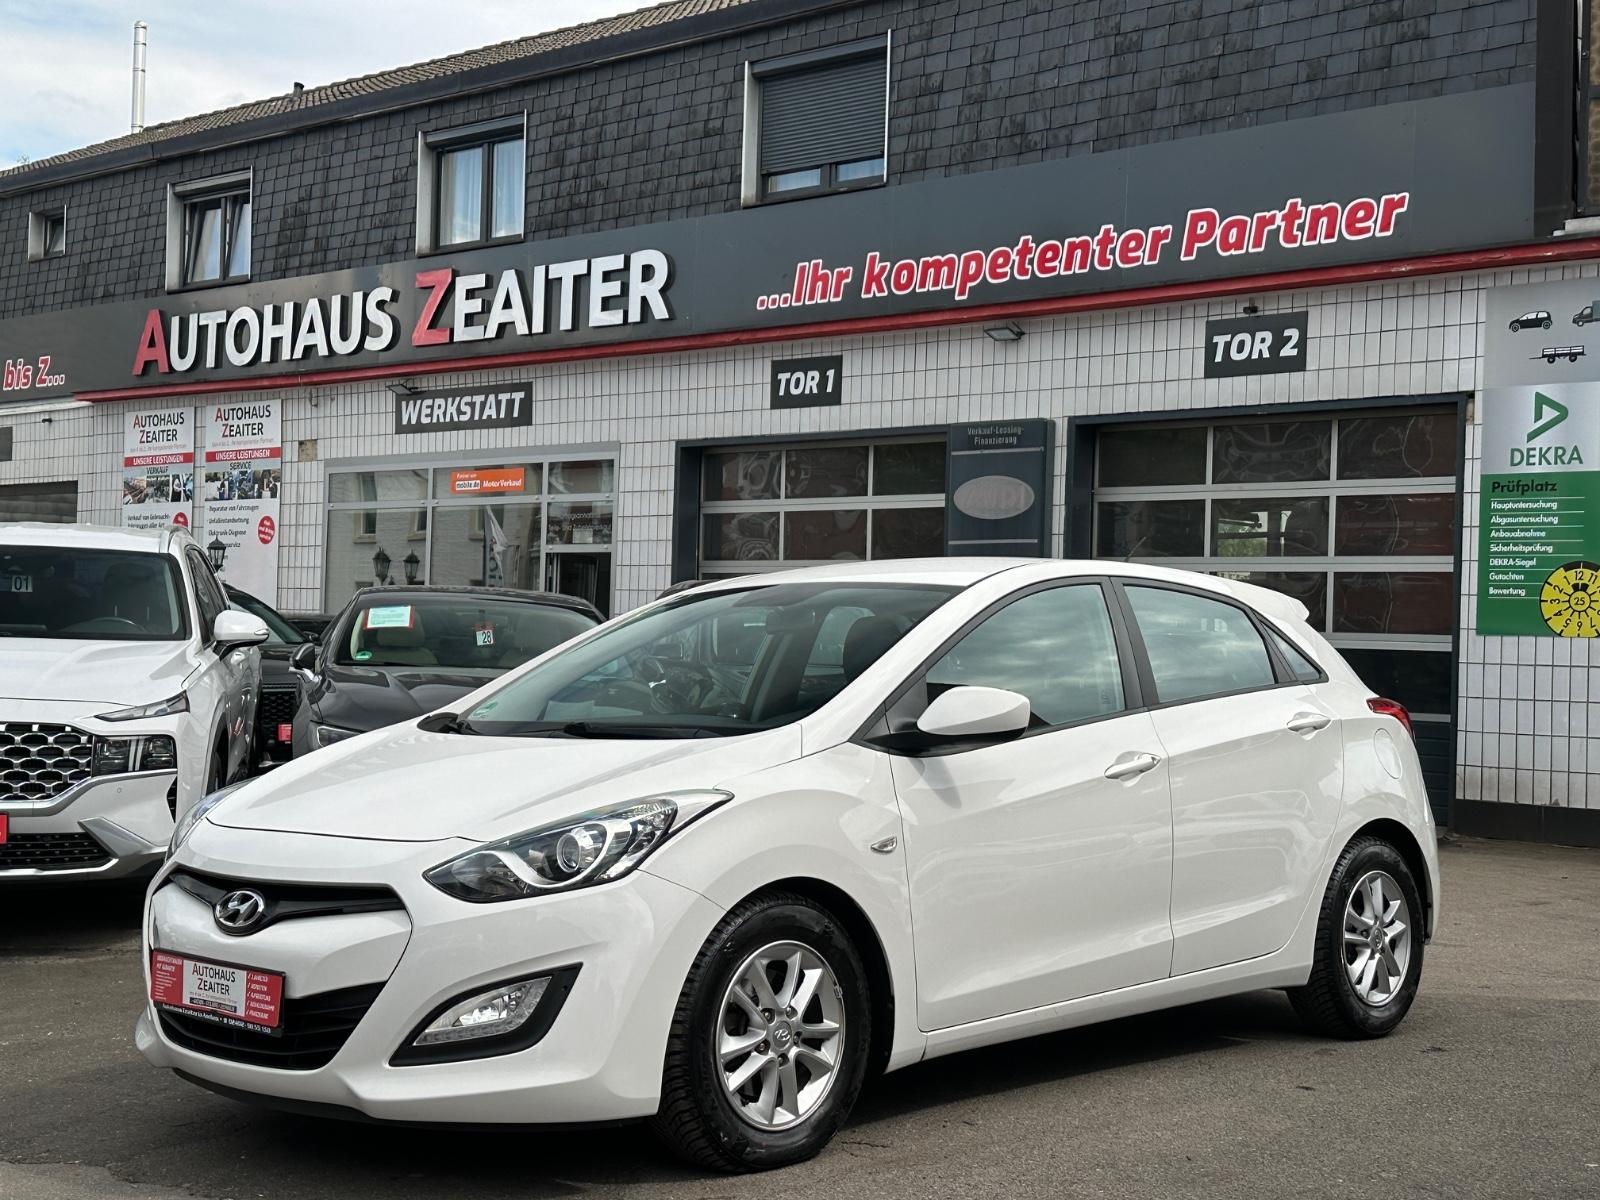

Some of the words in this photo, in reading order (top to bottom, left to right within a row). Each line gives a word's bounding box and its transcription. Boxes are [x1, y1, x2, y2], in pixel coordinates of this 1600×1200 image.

[757, 259, 853, 310] ...Ihr
[861, 224, 1172, 300] kompetenter
[1180, 192, 1409, 261] Partner
[132, 286, 396, 376] AUTOHAUS
[411, 249, 672, 347] ZEAITER
[1212, 331, 1273, 363] TOR
[1280, 328, 1300, 357] 2
[3, 358, 33, 391] bis
[36, 355, 65, 387] Z...
[777, 370, 820, 396] TOR
[826, 369, 835, 393] 1
[215, 405, 271, 422] AUTOHAUS
[401, 391, 525, 425] WERKSTATT
[133, 412, 185, 429] AUTOHAUS
[222, 422, 264, 438] ZEAITER
[139, 429, 178, 444] ZEAITER
[974, 435, 1017, 446] Finanzierung
[237, 449, 271, 459] LEISTUNGEN
[1509, 445, 1584, 467] DEKRA
[229, 461, 252, 471] SERVICE
[1491, 480, 1558, 495] Prüfplatz
[1491, 500, 1558, 510] Hauptuntersuchung
[1490, 514, 1559, 525] Abgasuntersuchung
[1490, 529, 1546, 538] Anbauabnahme
[1489, 543, 1554, 553] Sicherheitsprüfung
[1489, 558, 1537, 568] DEKRA-Siegel
[1489, 572, 1525, 580] Gutachten
[1563, 575, 1571, 585] 1
[1574, 570, 1584, 581] 12
[1587, 572, 1598, 585] 11
[14, 576, 29, 591] 01
[1553, 584, 1564, 594] 2
[1488, 586, 1526, 597] Bewertung
[1573, 597, 1586, 606] 25
[1552, 609, 1563, 617] 4
[1562, 617, 1572, 629] 5
[1576, 621, 1583, 631] 6
[1590, 616, 1597, 628] 7
[482, 630, 492, 644] 28
[192, 963, 236, 983] AUTOHAUS
[197, 978, 230, 996] ZEAITER
